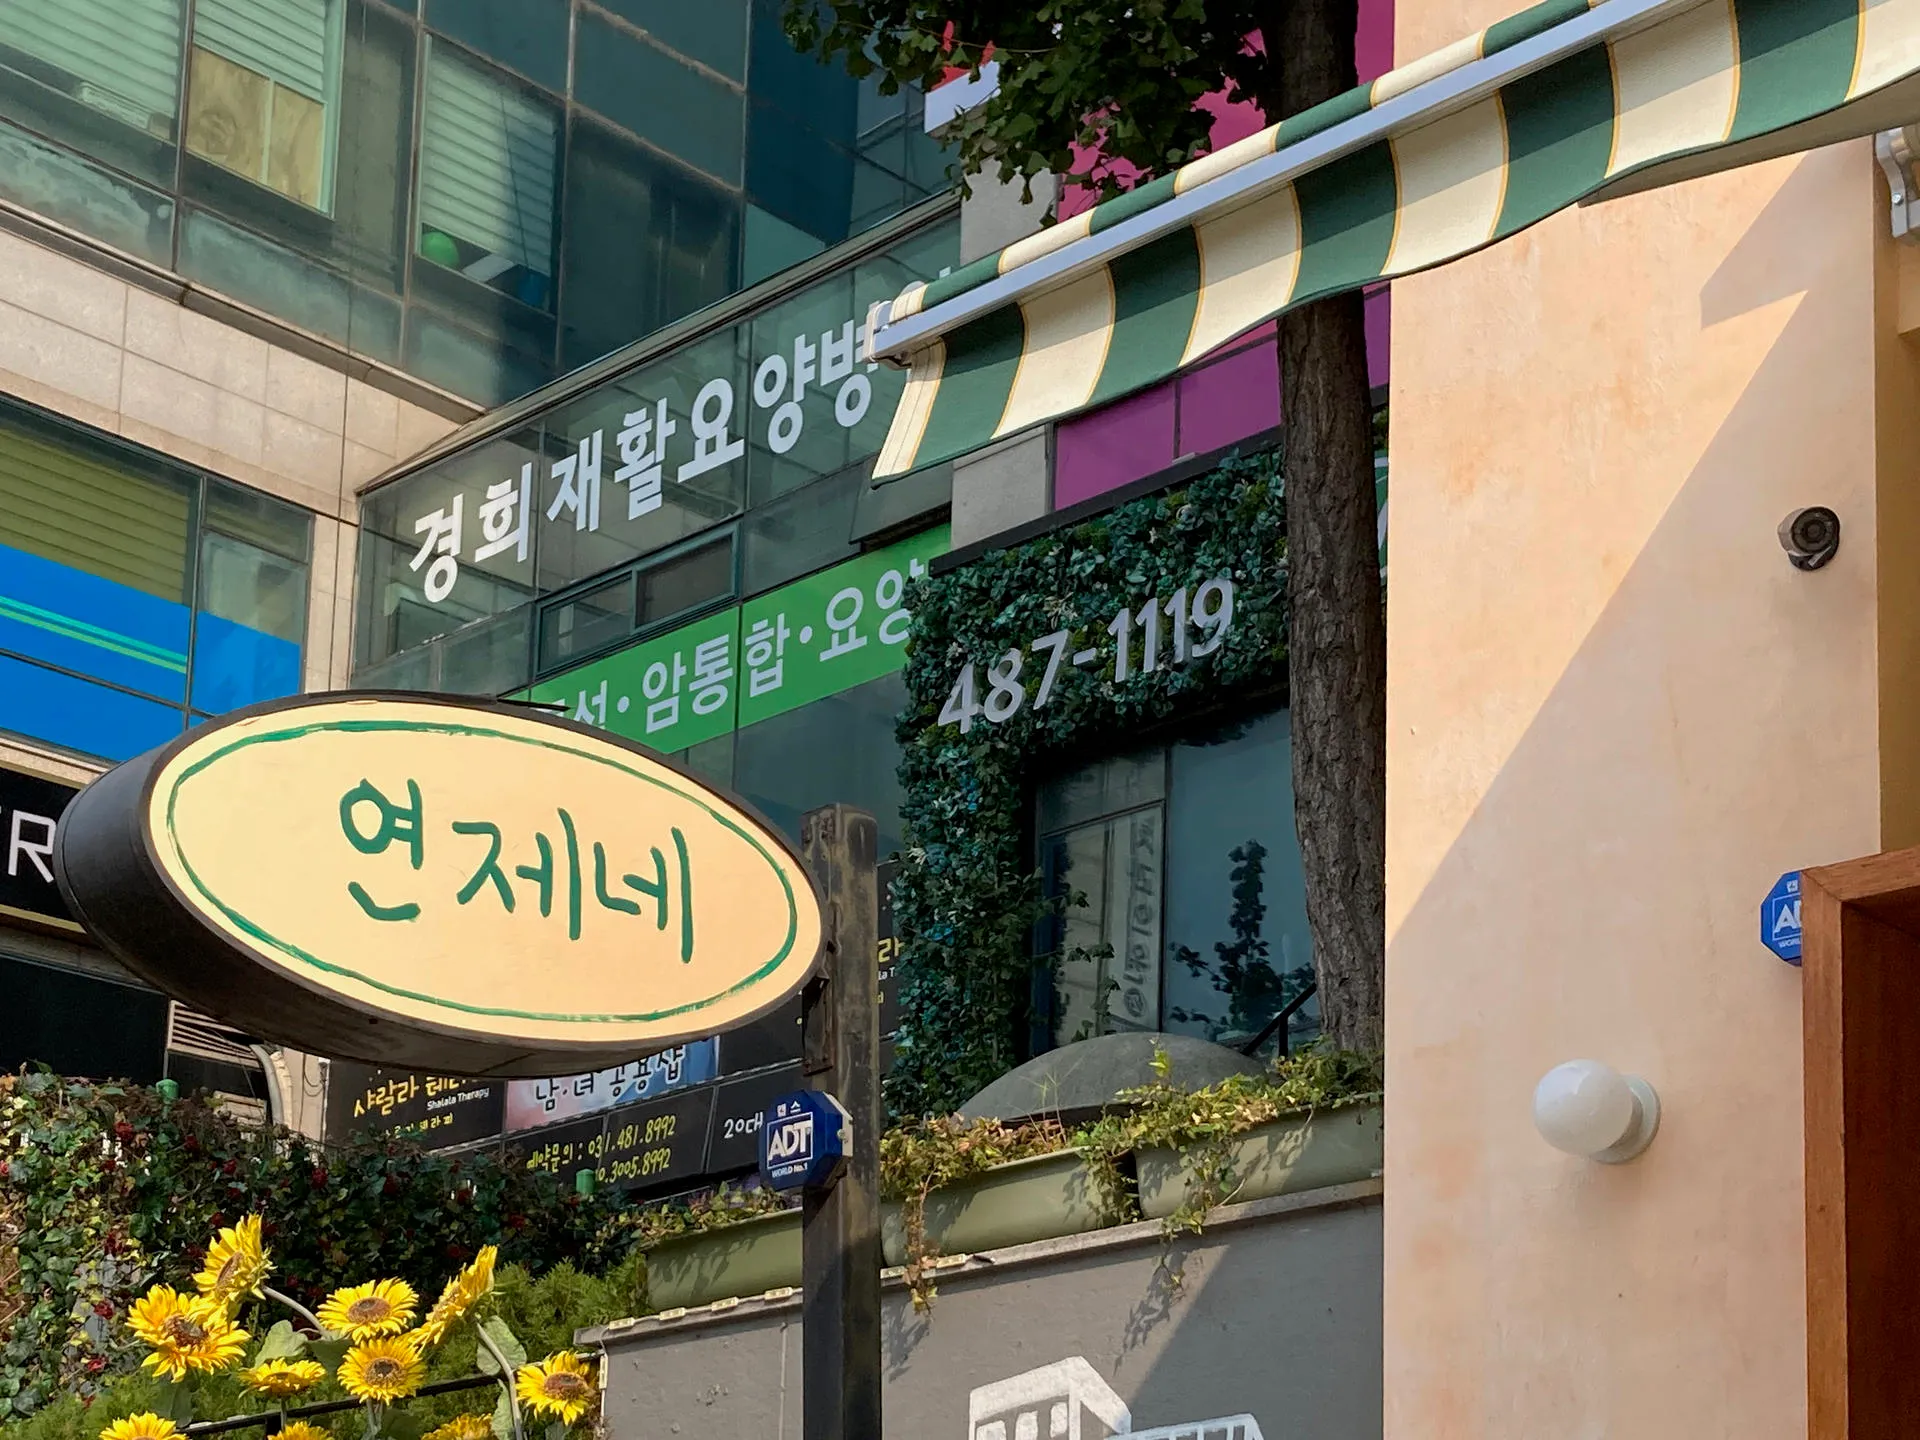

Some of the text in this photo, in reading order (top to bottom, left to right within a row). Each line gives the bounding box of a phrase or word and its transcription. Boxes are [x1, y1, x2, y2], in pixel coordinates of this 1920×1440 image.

[408, 266, 951, 603] 경희재활요양병
[534, 558, 927, 735] 선·암통합·요양
[937, 577, 1234, 735] 487-1119
[0, 805, 57, 884] R
[339, 778, 694, 964] 연제네
[768, 1120, 812, 1161] ADT
